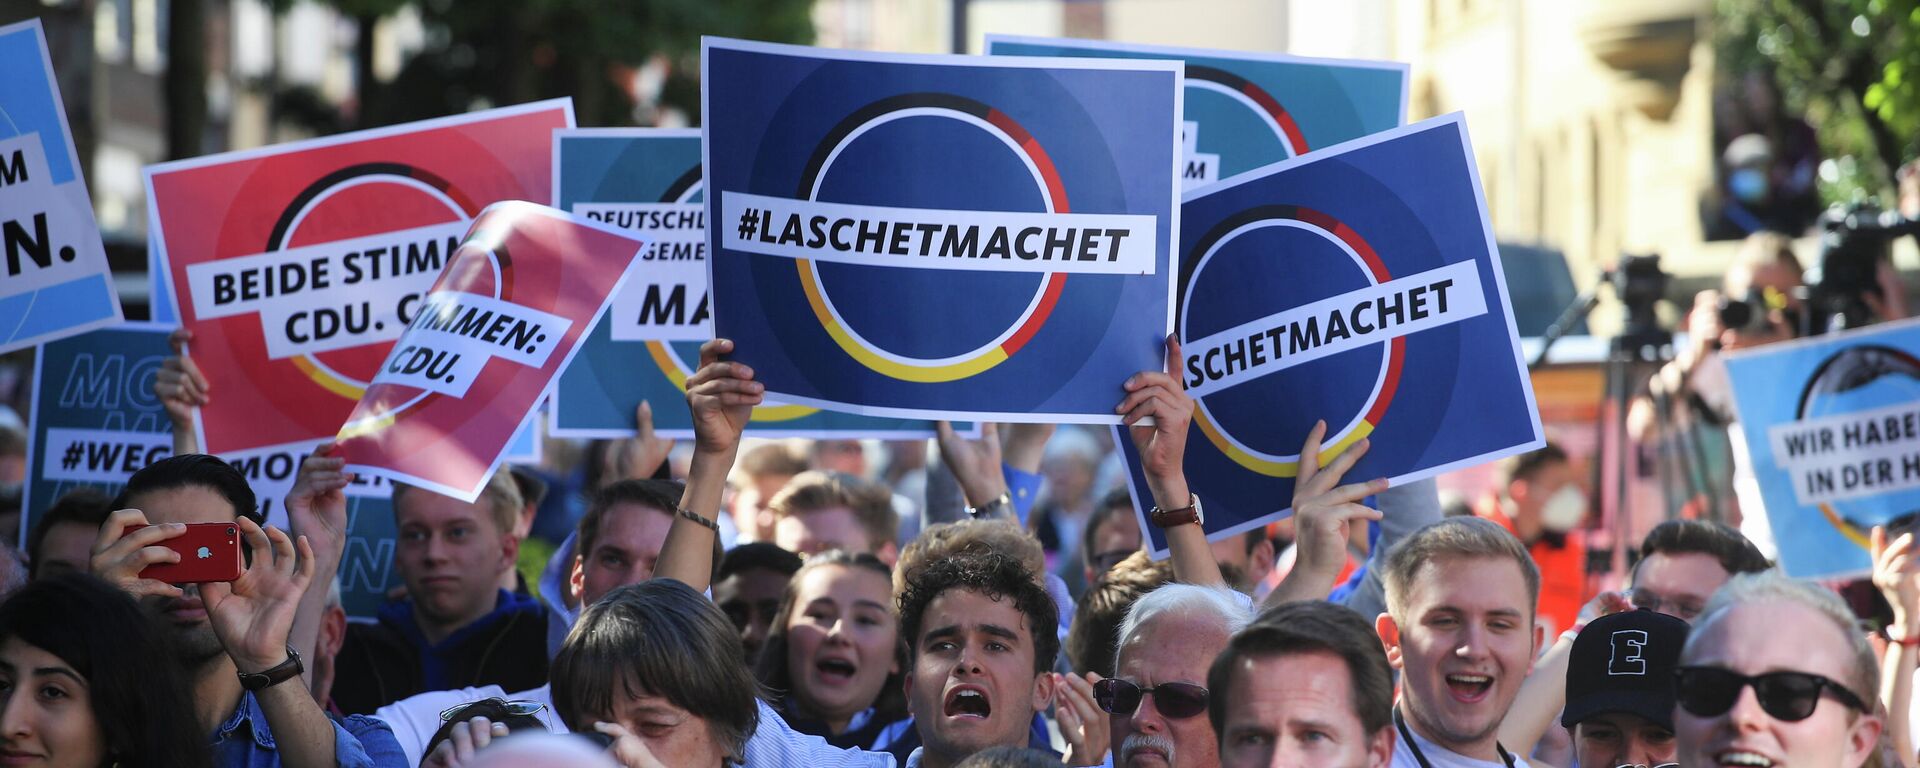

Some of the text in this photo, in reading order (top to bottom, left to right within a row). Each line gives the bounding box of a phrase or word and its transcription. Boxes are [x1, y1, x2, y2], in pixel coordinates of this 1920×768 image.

[2, 212, 76, 276] N.
[738, 207, 1130, 263] #LASCHETMACHET
[213, 257, 330, 306] BEIDE
[285, 302, 384, 344] CDU.
[1183, 278, 1453, 391] SCHETMACHET
[388, 346, 461, 384] CDU.
[1783, 412, 1920, 457] WIR HABE
[1806, 468, 1834, 495] IN
[1842, 459, 1893, 489] DER
[1608, 629, 1648, 675] E
